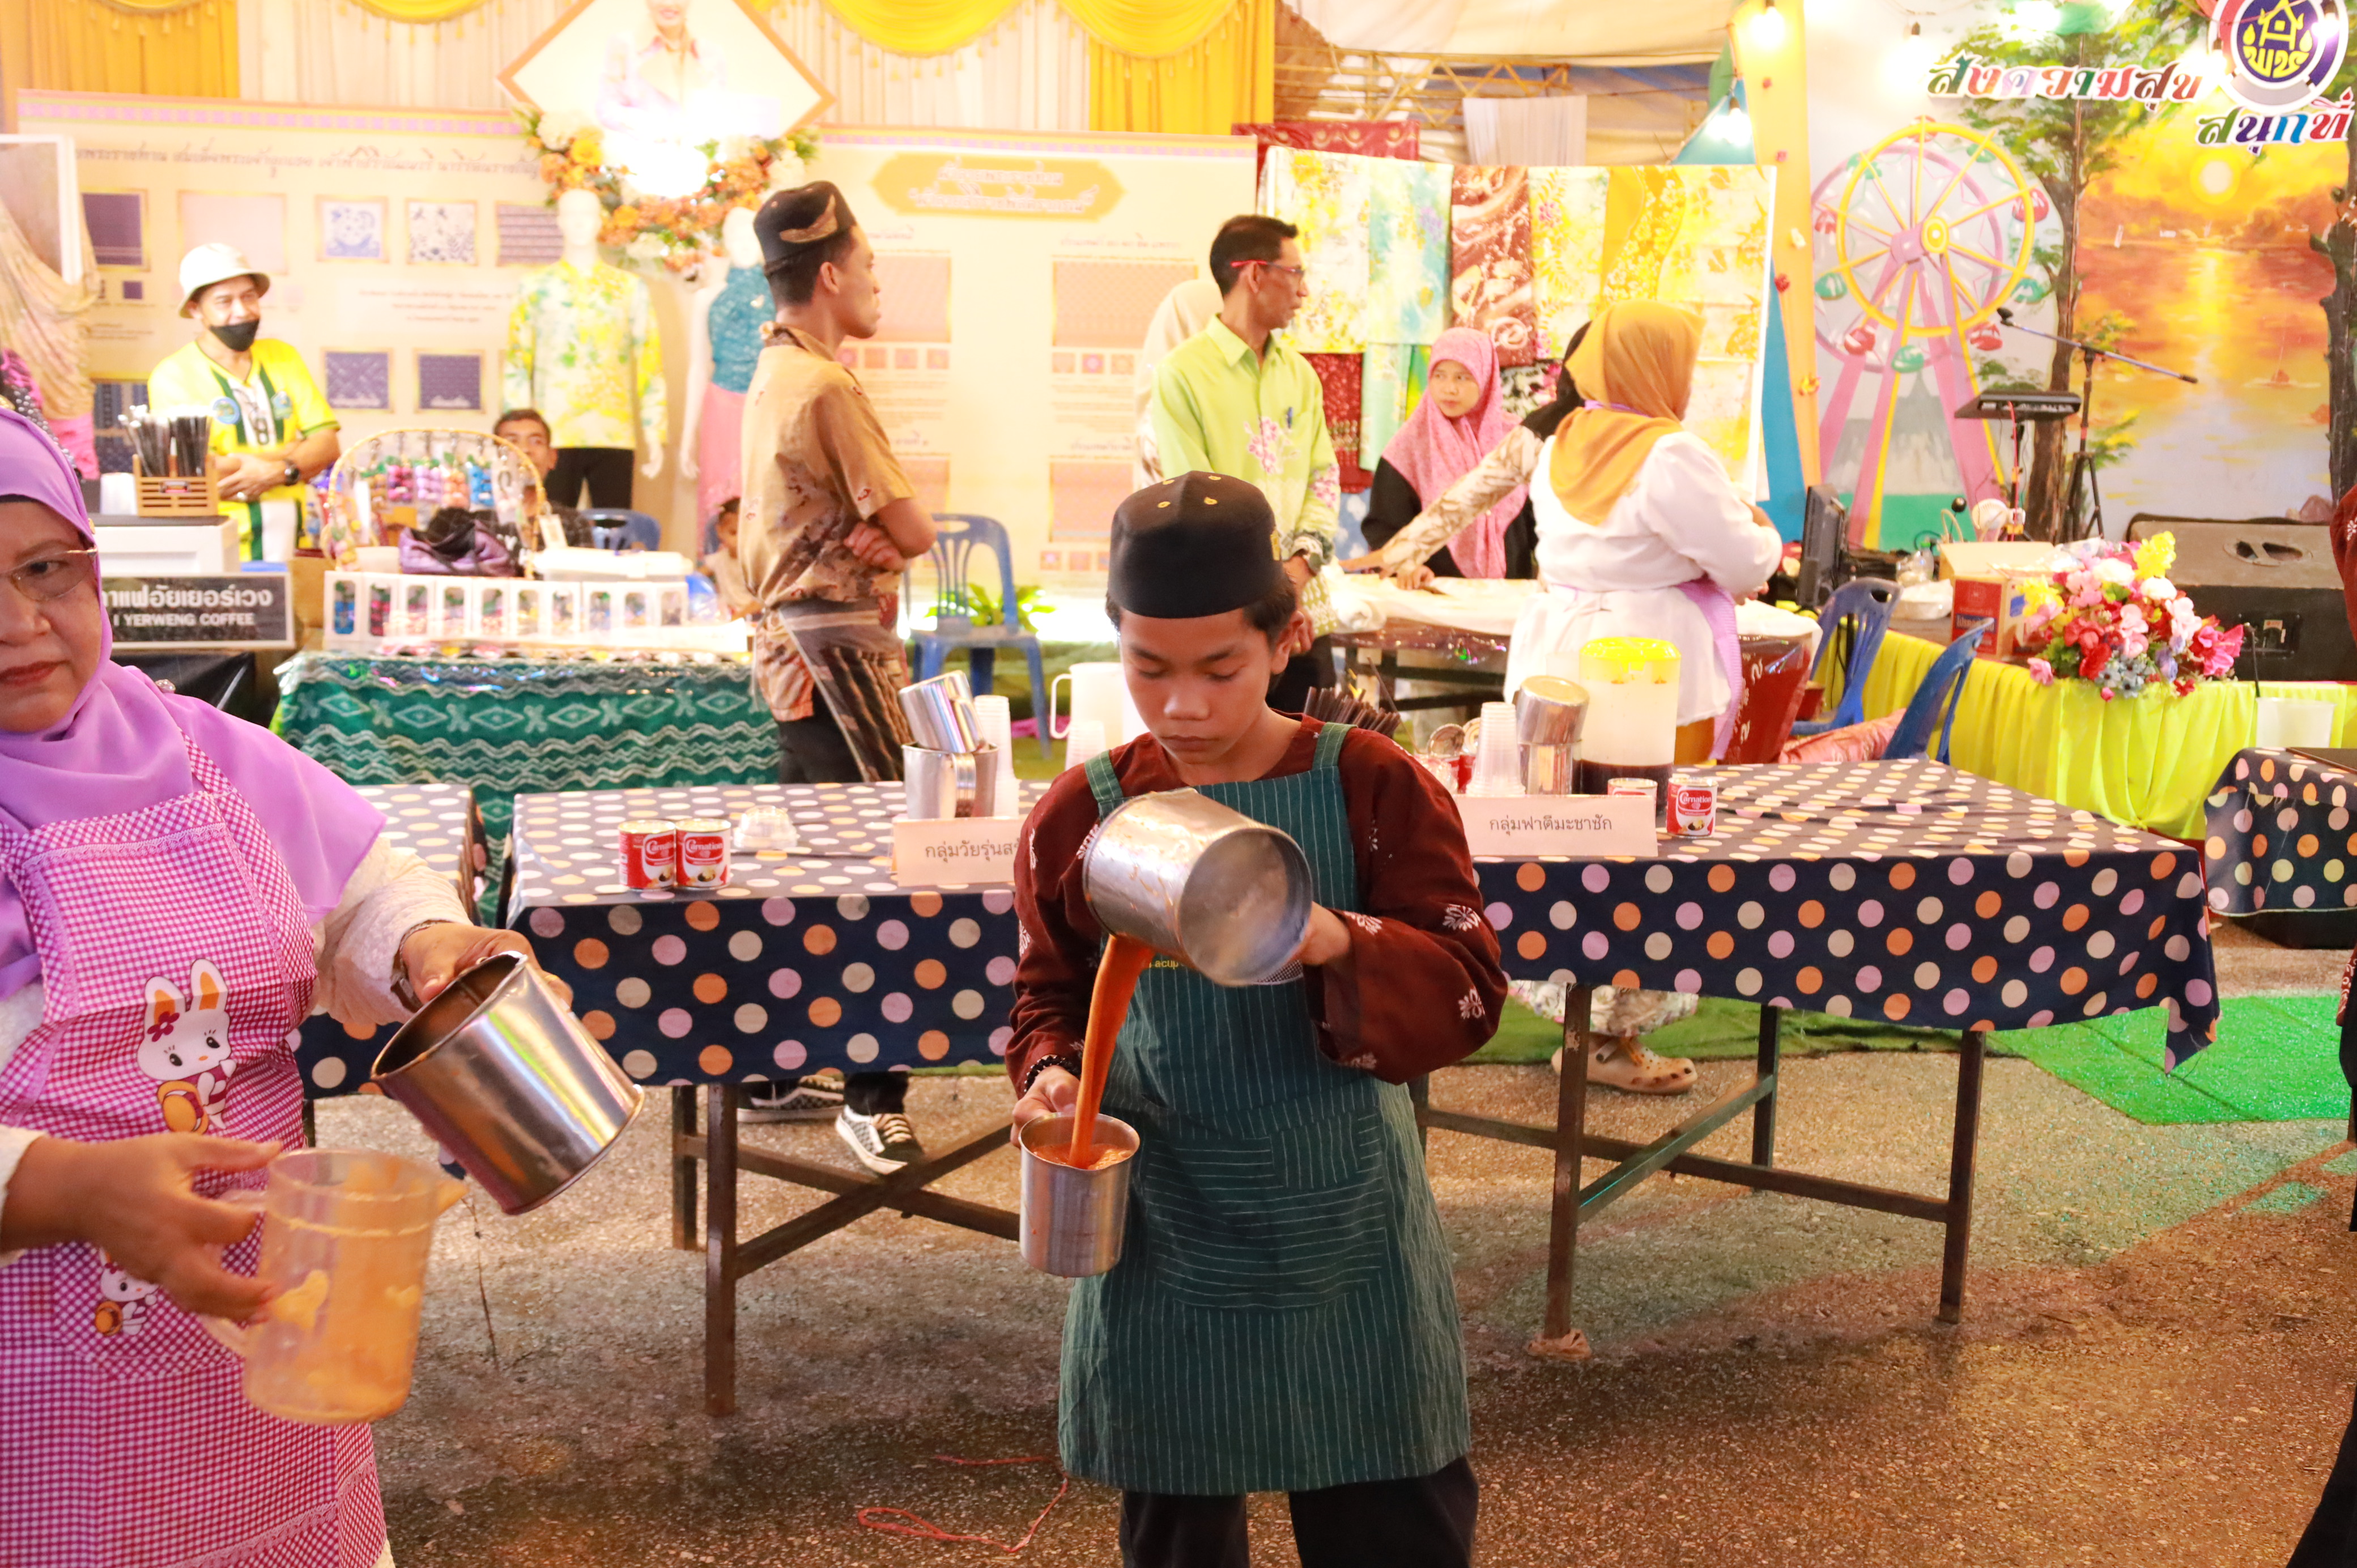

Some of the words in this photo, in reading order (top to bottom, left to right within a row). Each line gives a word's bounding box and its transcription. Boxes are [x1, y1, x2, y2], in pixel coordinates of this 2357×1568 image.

[123, 613, 196, 627] YERWENG
[199, 612, 255, 625] COFFEE
[1679, 792, 1712, 804] Carnation
[686, 840, 723, 853] Carnation
